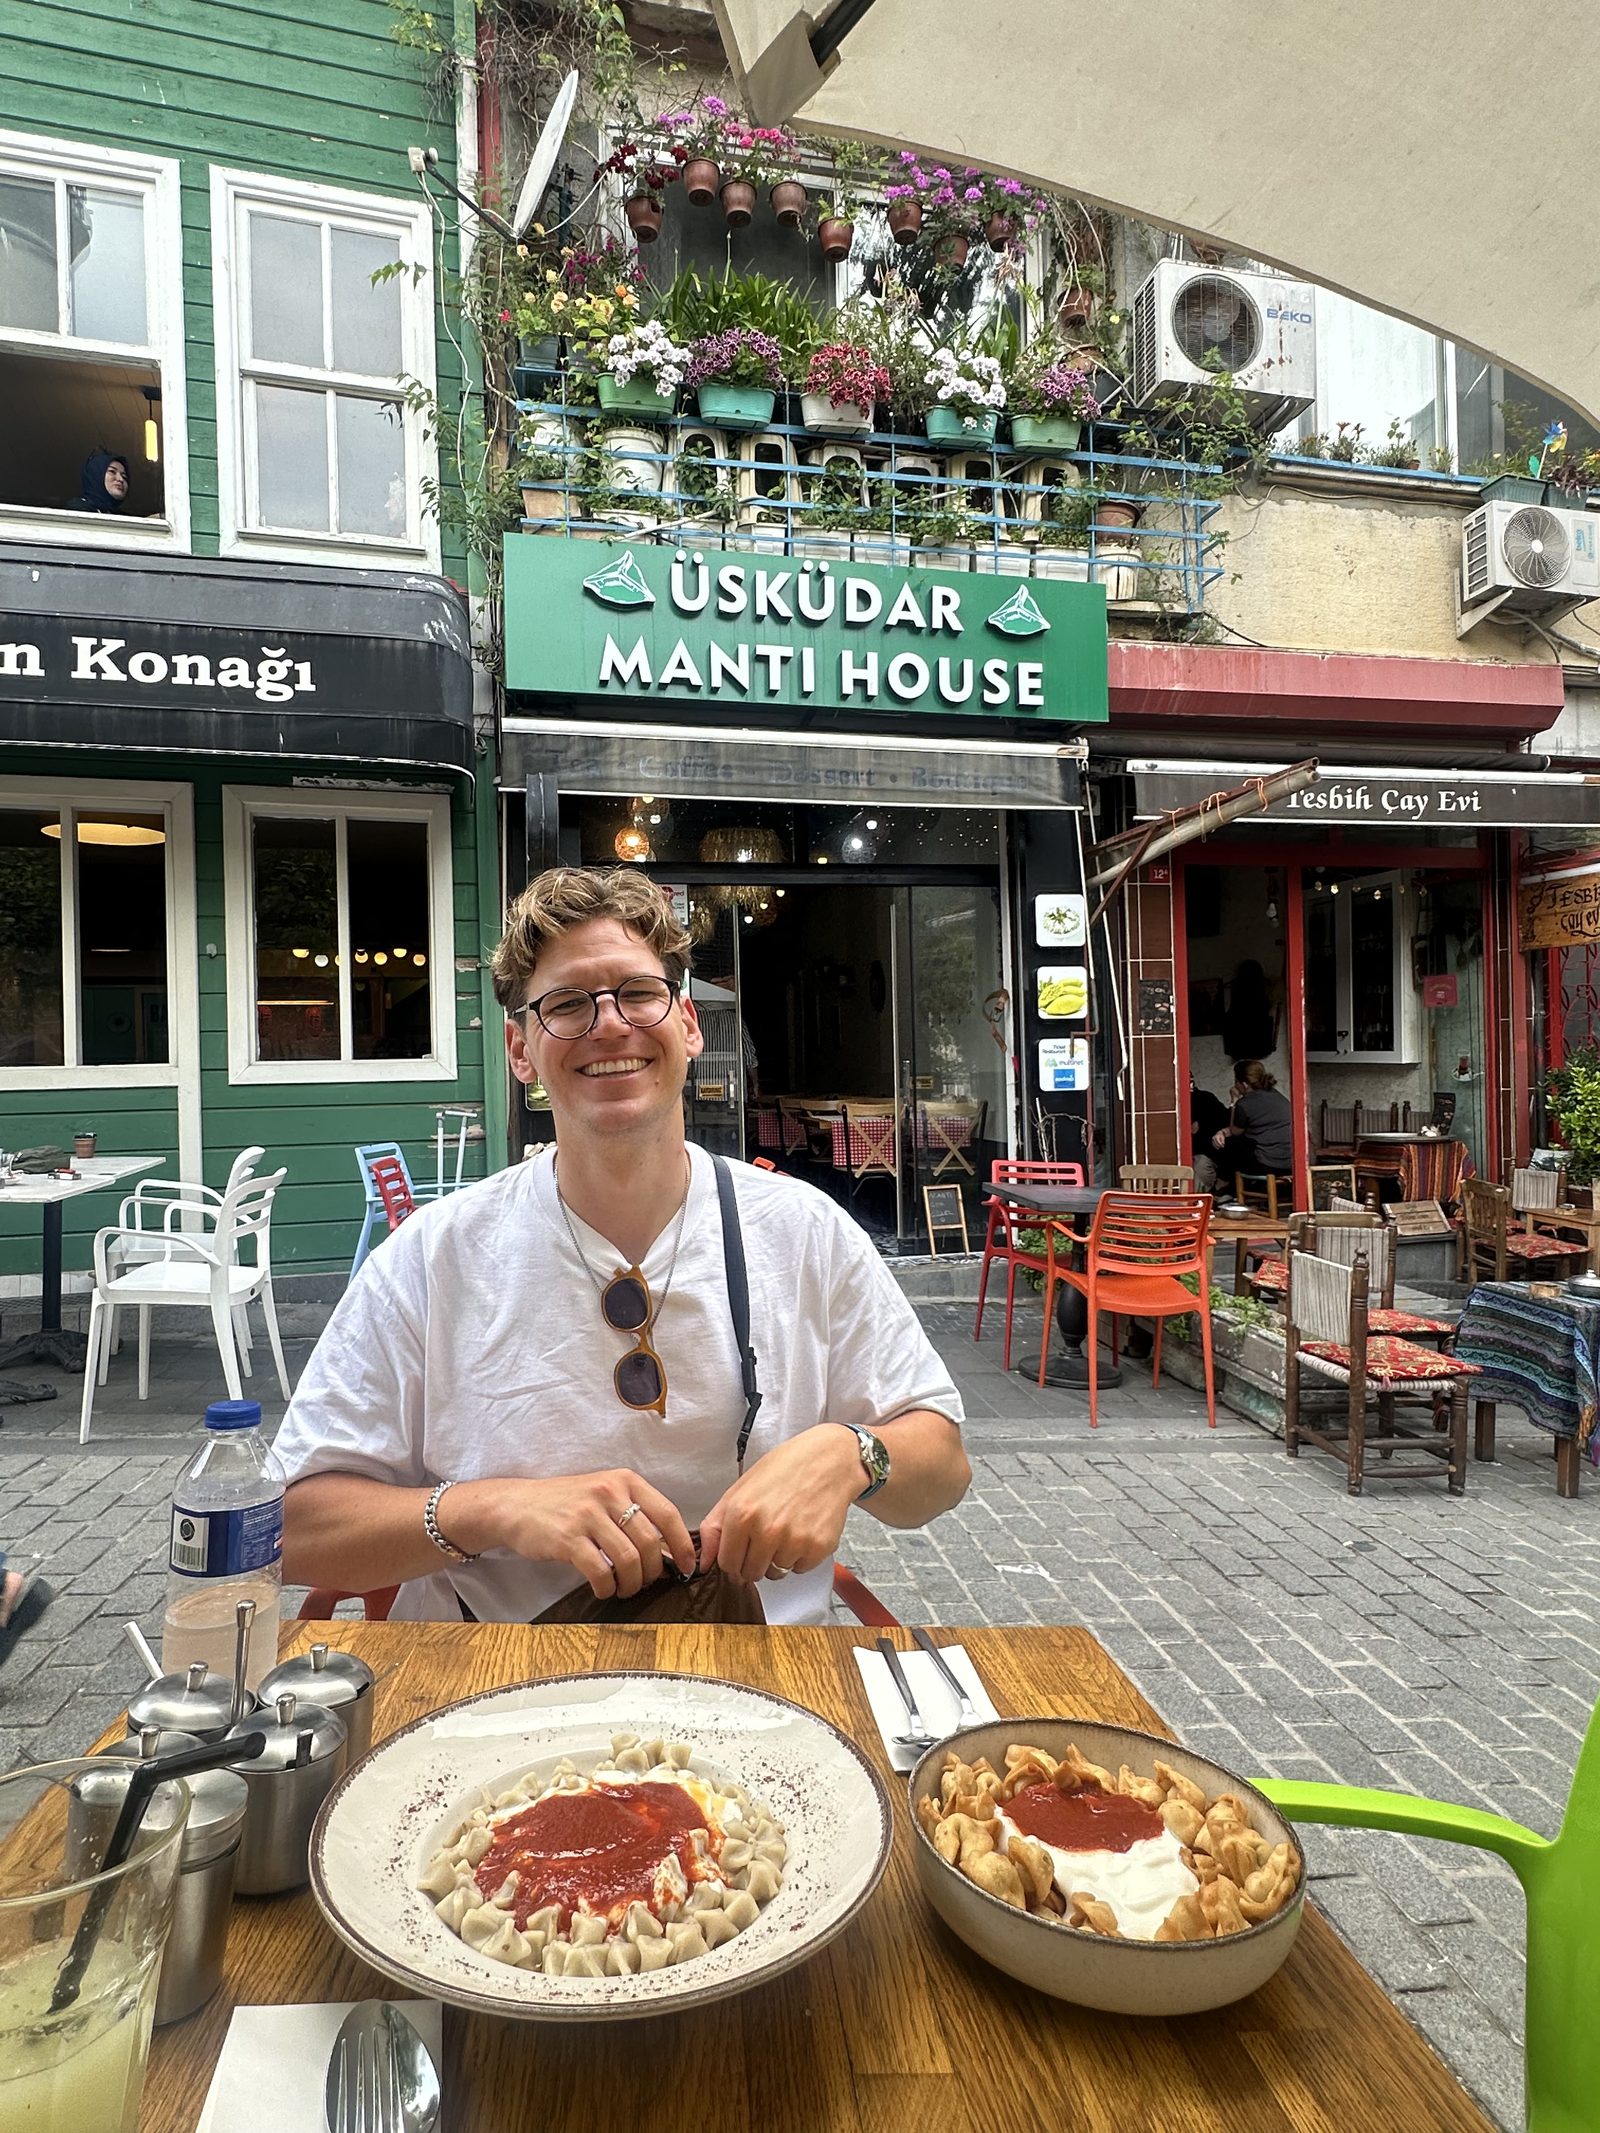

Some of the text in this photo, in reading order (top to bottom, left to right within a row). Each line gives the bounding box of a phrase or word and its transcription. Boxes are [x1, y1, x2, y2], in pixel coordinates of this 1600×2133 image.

[1266, 307, 1312, 325] BEKO
[669, 549, 965, 634] ÜSKÜDAR
[70, 636, 317, 702] Konağı
[599, 634, 1045, 706] MANTI HOUSE
[1381, 789, 1429, 820] Çay
[1437, 790, 1482, 812] Evi
